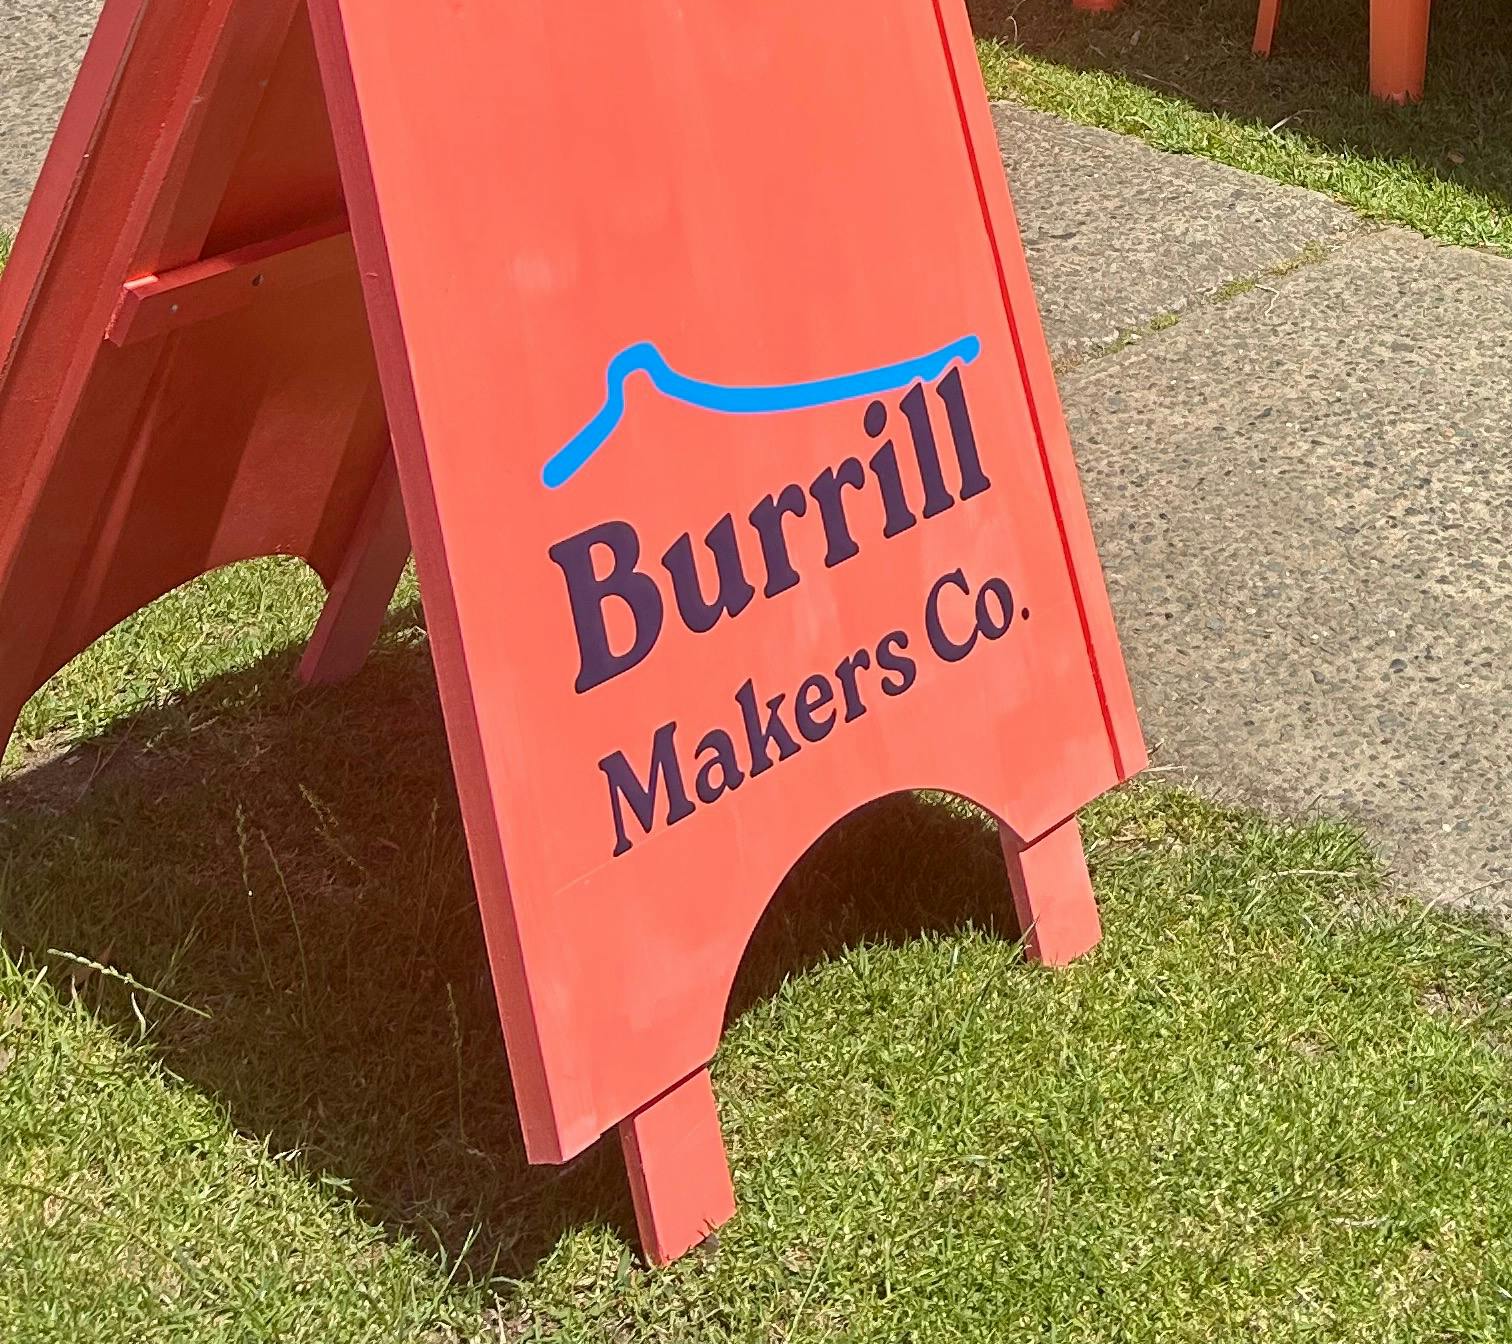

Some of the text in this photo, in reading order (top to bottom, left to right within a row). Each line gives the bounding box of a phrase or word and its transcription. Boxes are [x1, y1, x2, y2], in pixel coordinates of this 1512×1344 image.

[548, 366, 992, 695] Burrill
[598, 567, 1030, 858] Makers Co.
